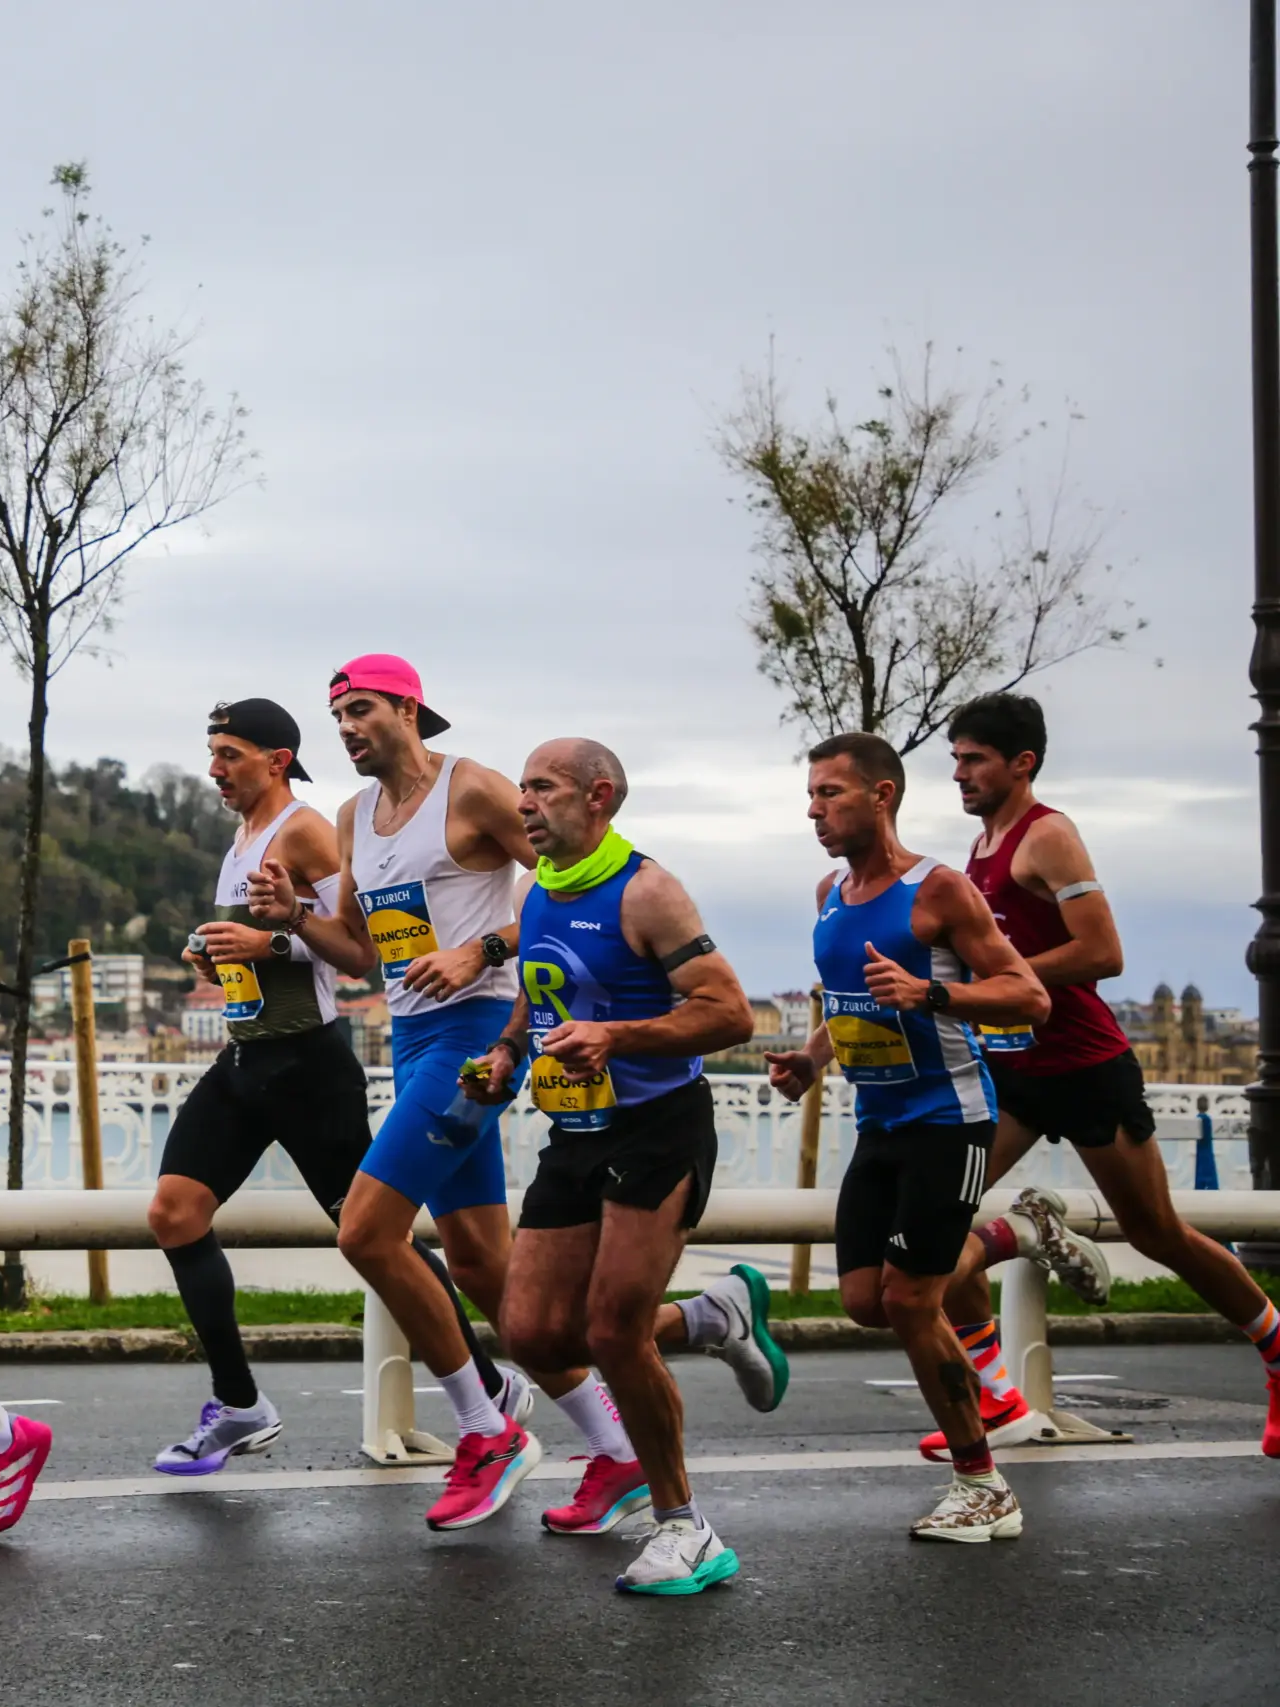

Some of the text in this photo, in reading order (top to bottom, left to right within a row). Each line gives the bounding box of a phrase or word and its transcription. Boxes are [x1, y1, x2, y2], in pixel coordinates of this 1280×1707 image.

[375, 889, 411, 906] ZURICH
[390, 947, 404, 959] 917
[842, 1001, 880, 1012] ZURICH
[534, 1011, 554, 1026] CLUB
[560, 1097, 580, 1109] 432
